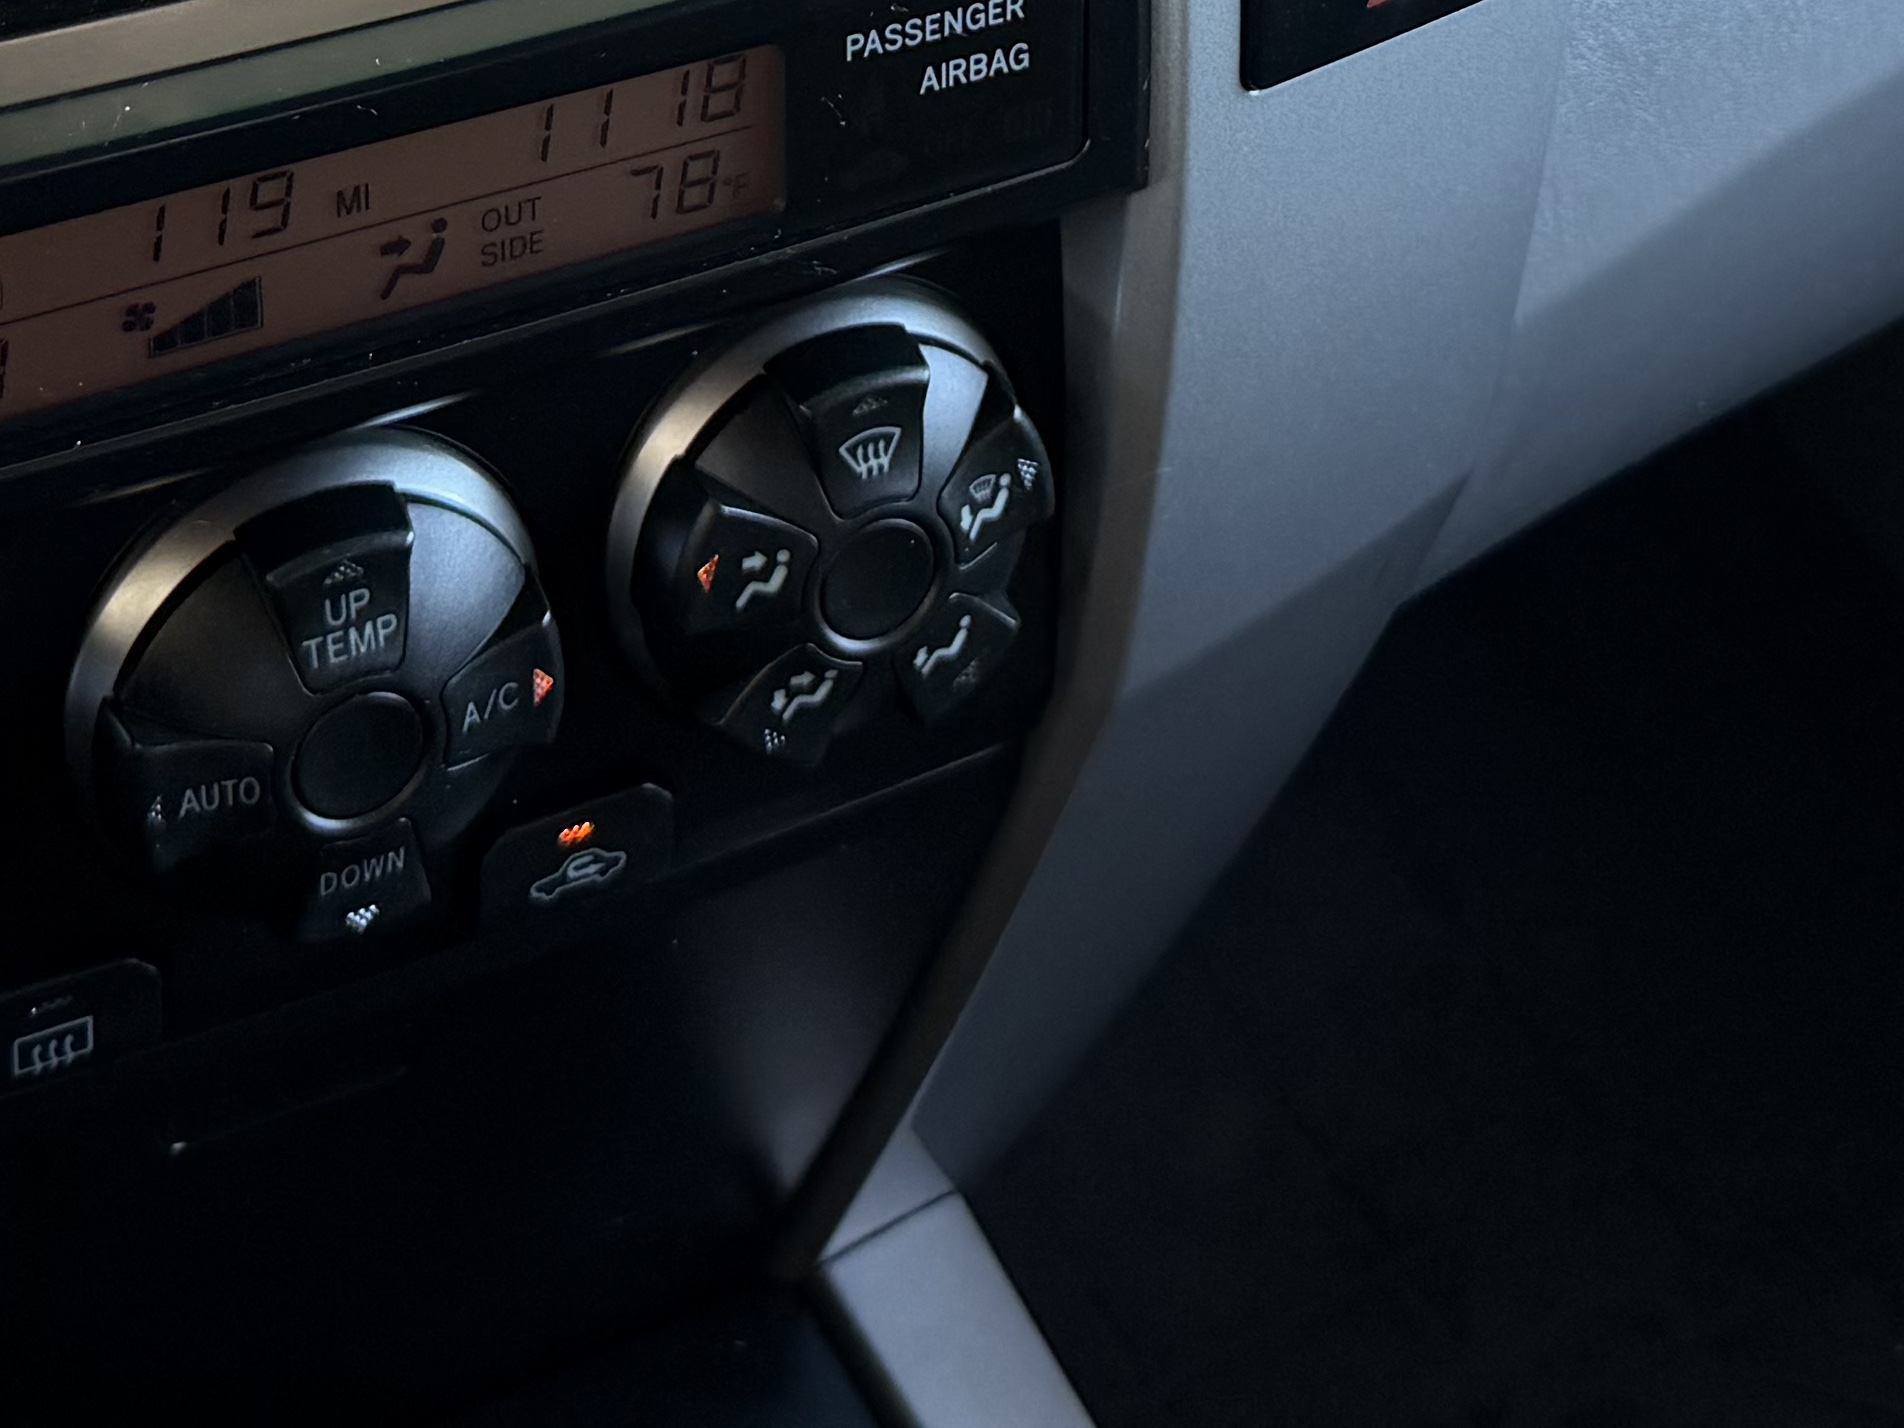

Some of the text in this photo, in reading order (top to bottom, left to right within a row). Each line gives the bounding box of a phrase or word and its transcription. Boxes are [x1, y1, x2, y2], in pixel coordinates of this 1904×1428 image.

[919, 42, 1030, 94] AIRBAG
[150, 170, 371, 262] 119 MI
[481, 197, 542, 233] OUT
[480, 231, 544, 267] SIDE
[325, 586, 370, 628] UP
[303, 613, 399, 670] TEMP
[462, 680, 519, 733] A/C
[179, 775, 259, 819] AUTO
[319, 847, 404, 894] DOWN
